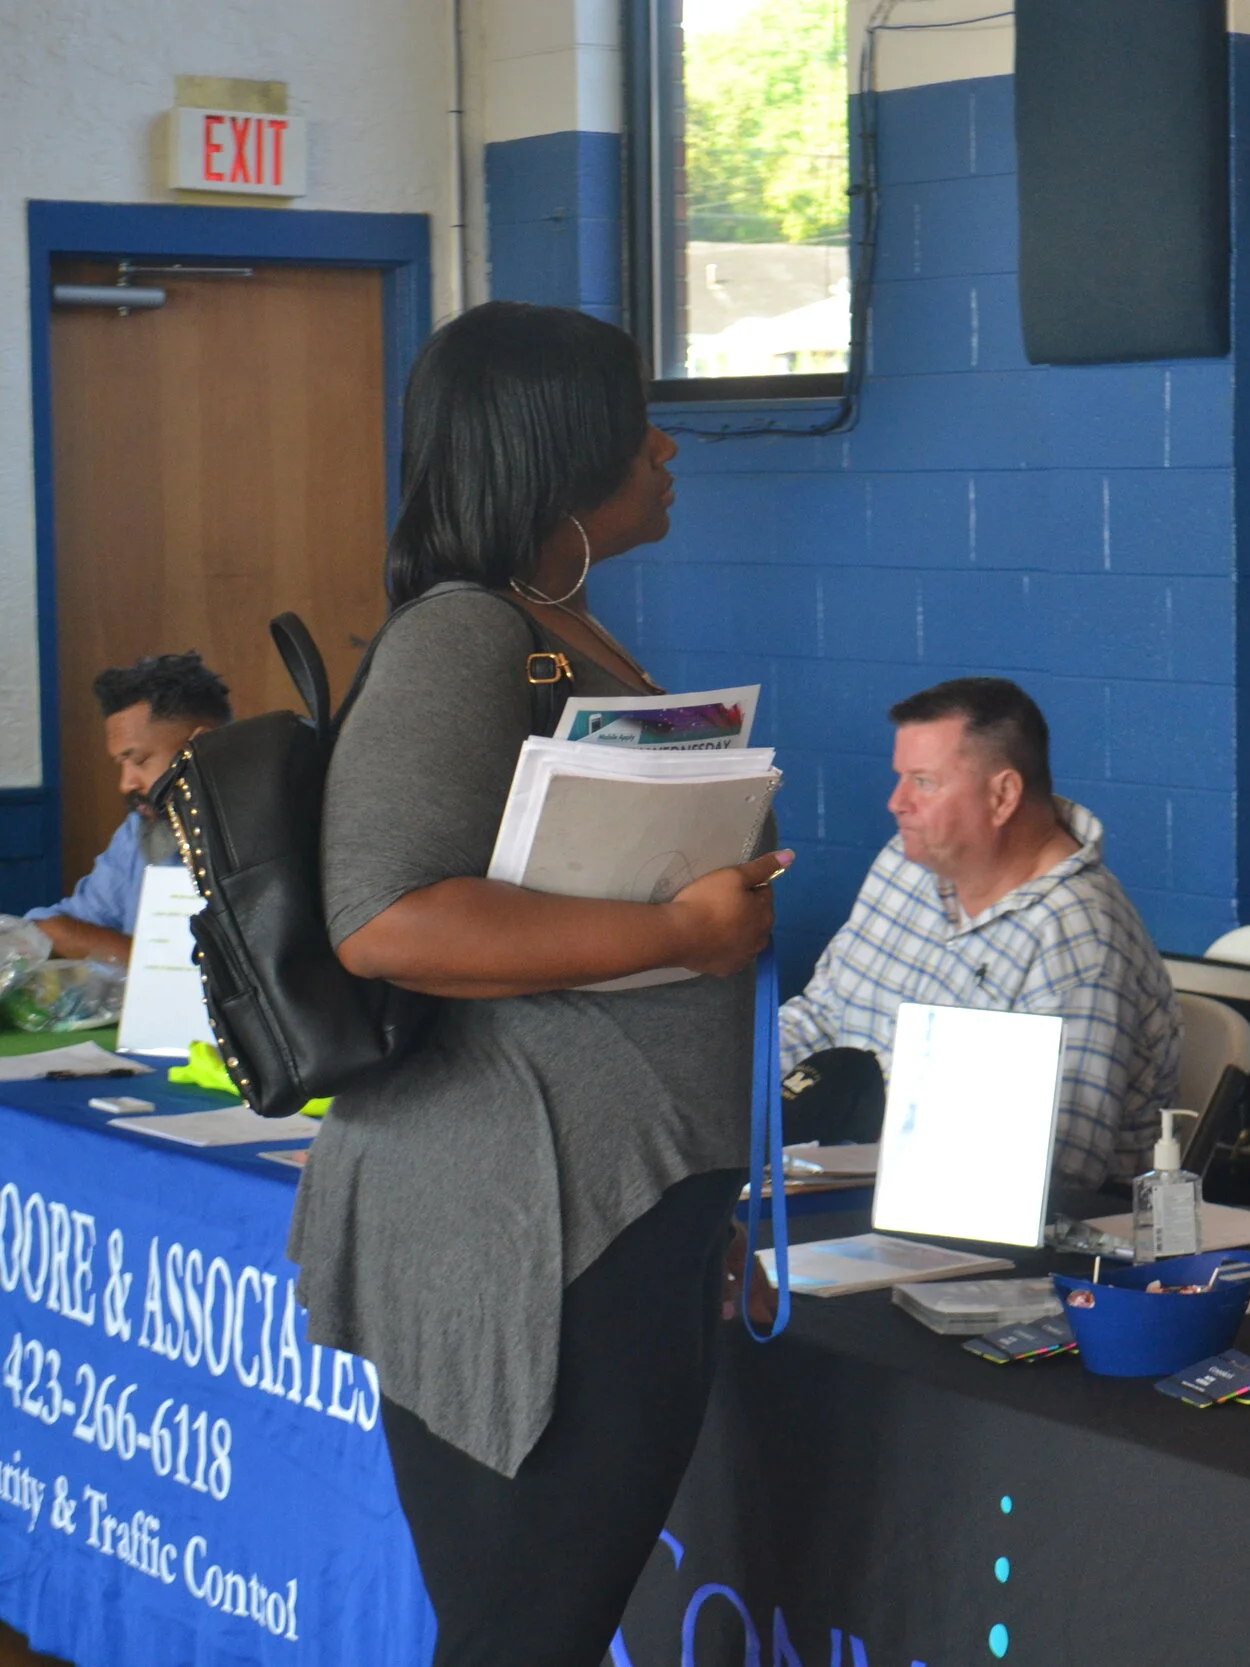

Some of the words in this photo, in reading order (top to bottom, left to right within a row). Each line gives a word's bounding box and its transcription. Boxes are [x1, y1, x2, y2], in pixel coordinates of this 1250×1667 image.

[204, 115, 288, 186] EXIT
[3, 1332, 232, 1501] 423-266-6118
[103, 1229, 133, 1343] &
[138, 1236, 381, 1432] ASSOCIATES
[0, 1450, 46, 1532] rity
[50, 1475, 77, 1535] &
[83, 1485, 178, 1585] Traffic
[184, 1535, 299, 1642] Control
